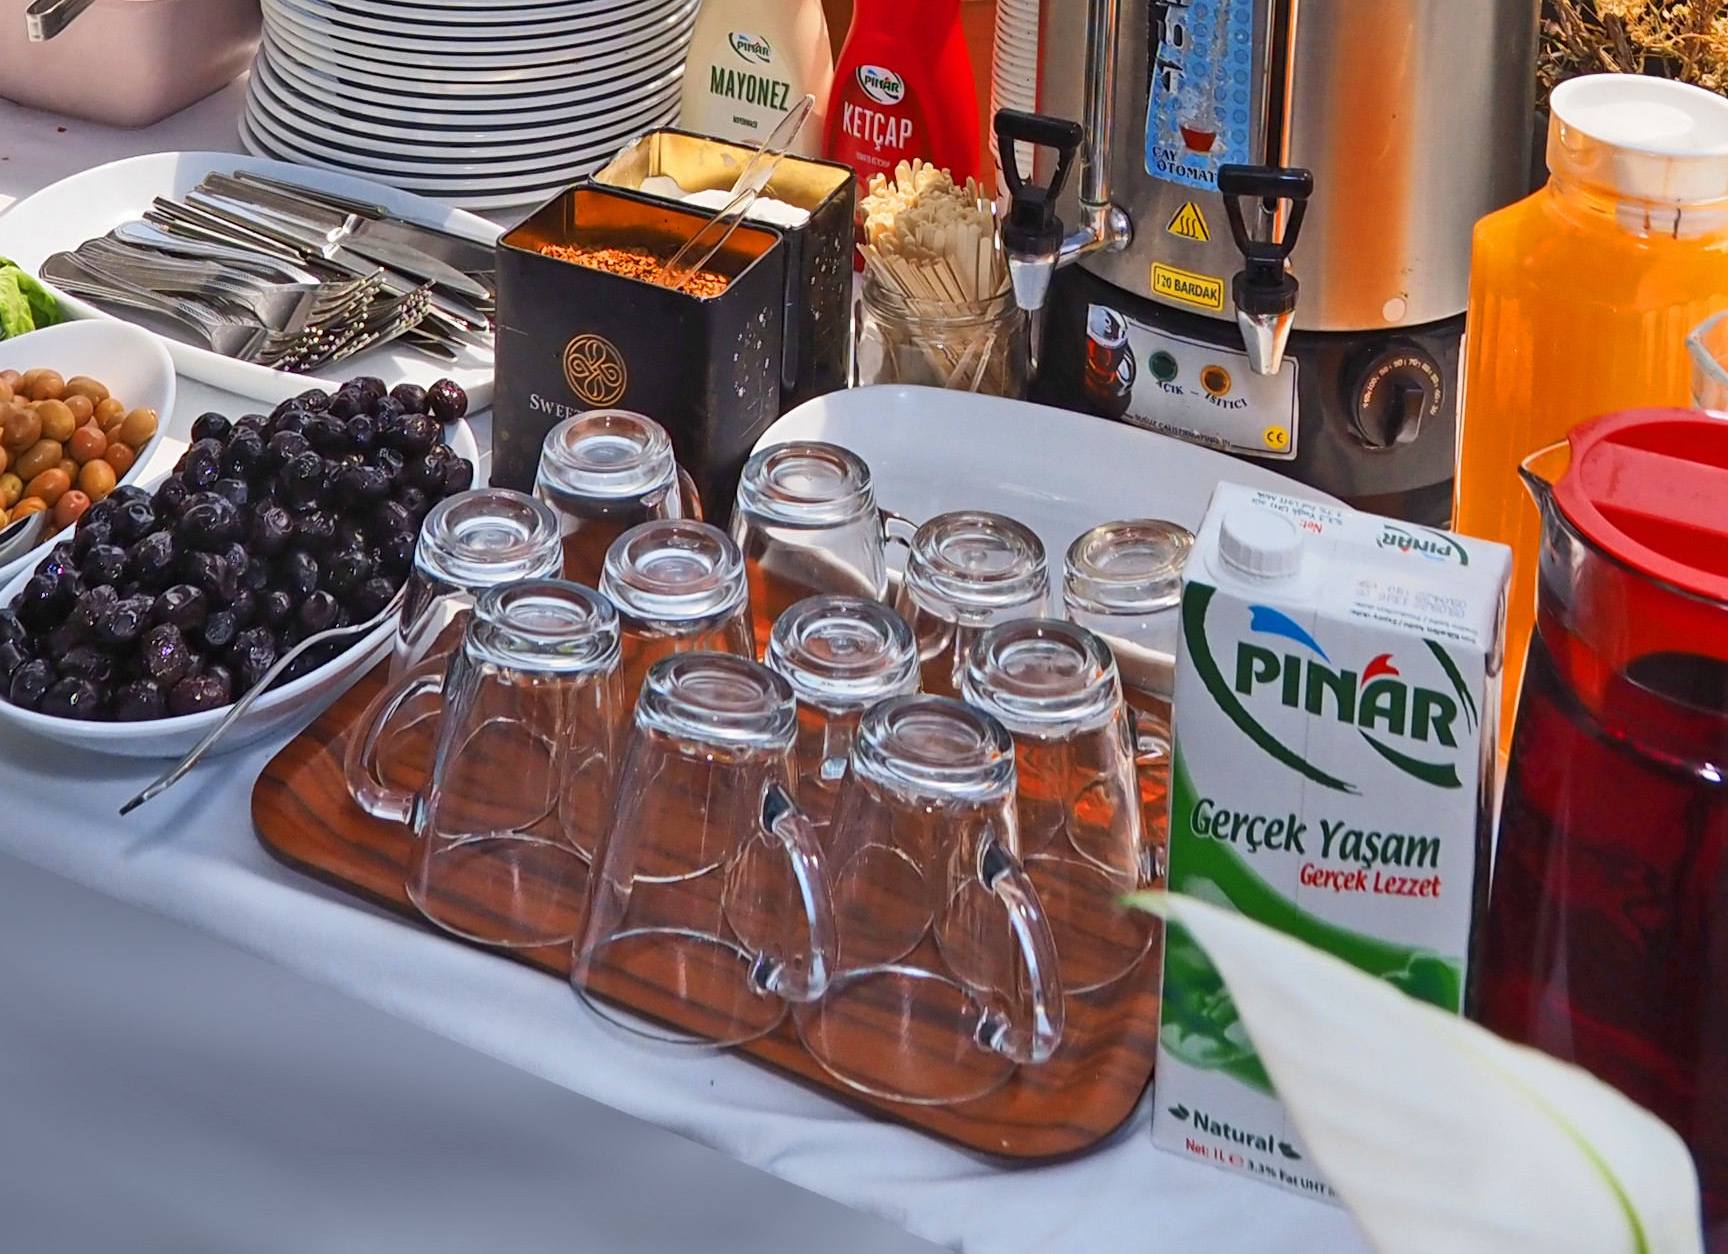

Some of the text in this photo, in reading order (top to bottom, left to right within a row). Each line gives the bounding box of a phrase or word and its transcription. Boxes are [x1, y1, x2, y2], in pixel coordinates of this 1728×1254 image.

[710, 65, 790, 112] MAYONEZ
[843, 101, 913, 152] KETÇAP
[1157, 159, 1219, 183] OTOMAT
[1157, 273, 1217, 301] 120 BARDAK
[1266, 429, 1284, 444] CE
[1382, 532, 1451, 556] PINAR
[1235, 641, 1459, 748] PINAR
[1191, 798, 1441, 869] Gerçek Yaşam
[1300, 862, 1441, 898] Gerçek Lezzet
[1194, 1109, 1274, 1154] Natural
[1300, 1177, 1327, 1193] UHT
